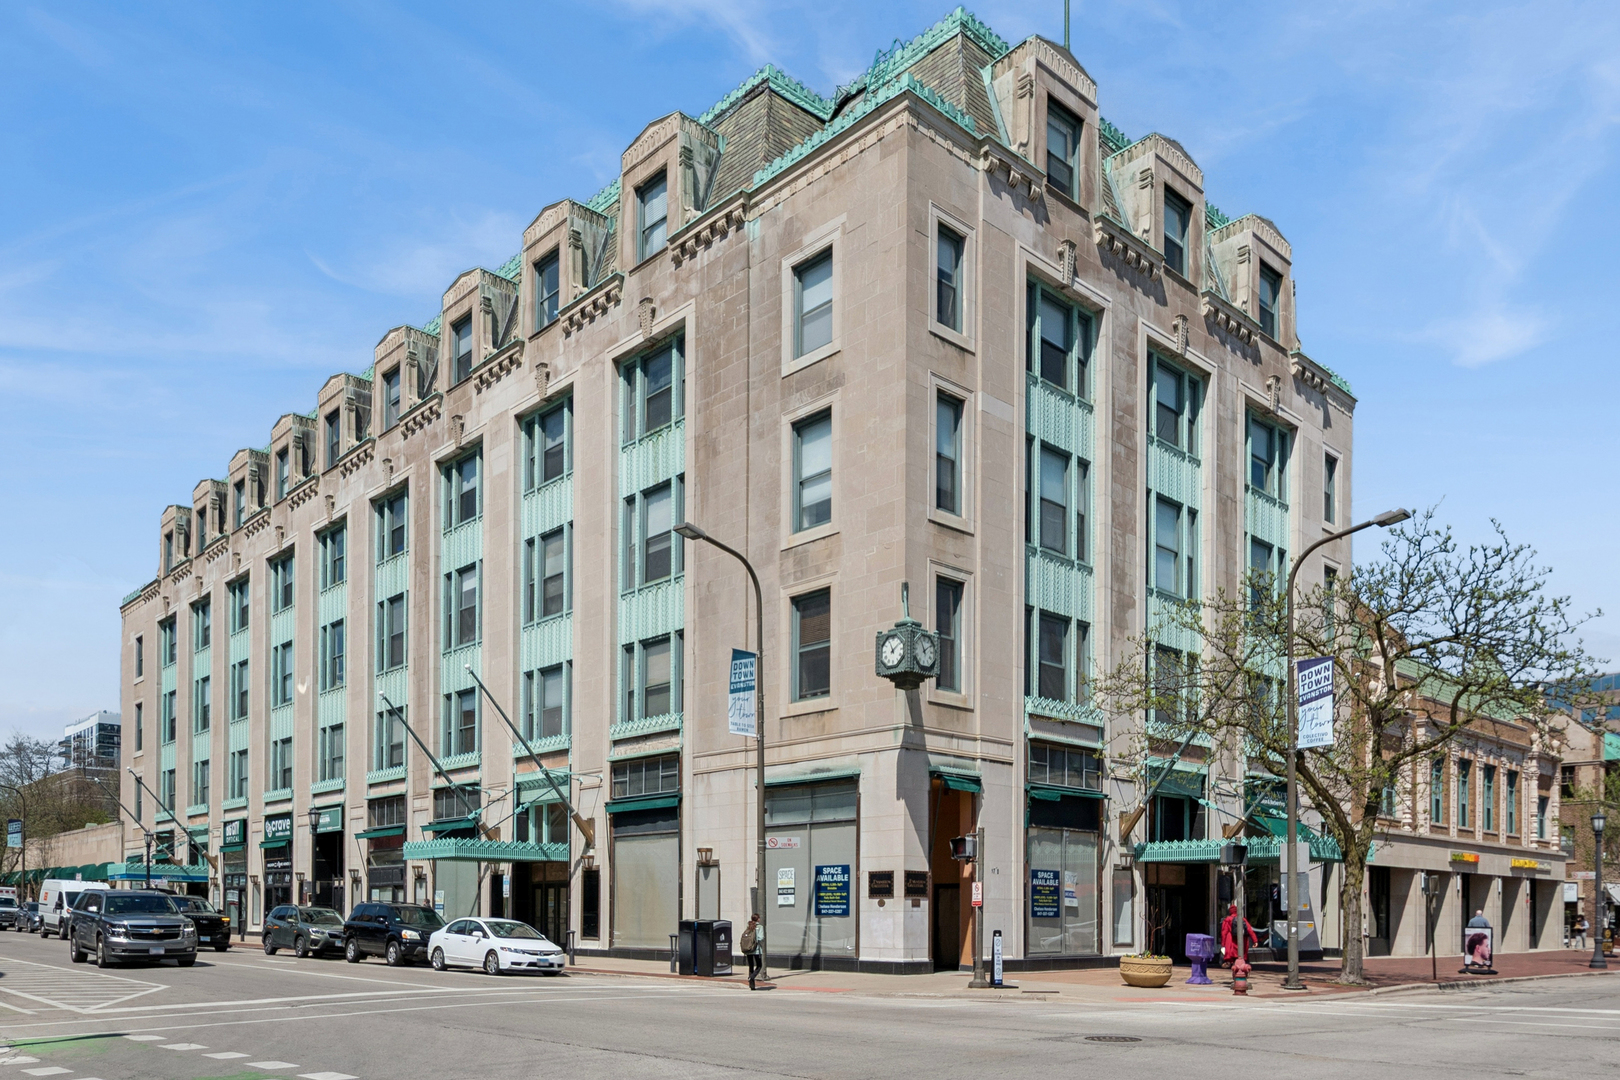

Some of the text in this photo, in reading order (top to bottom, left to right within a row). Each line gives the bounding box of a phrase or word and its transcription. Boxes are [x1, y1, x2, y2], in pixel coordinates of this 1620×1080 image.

[733, 660, 754, 670] DOWN
[733, 670, 754, 680] TOWN
[1300, 663, 1330, 682] DOWN
[730, 680, 755, 690] EVANSTON
[1301, 674, 1330, 692] TOWN
[1299, 684, 1332, 702] EVANSTON
[271, 818, 291, 831] crave
[822, 866, 842, 874] SPACE
[816, 874, 849, 882] AVAILABLE
